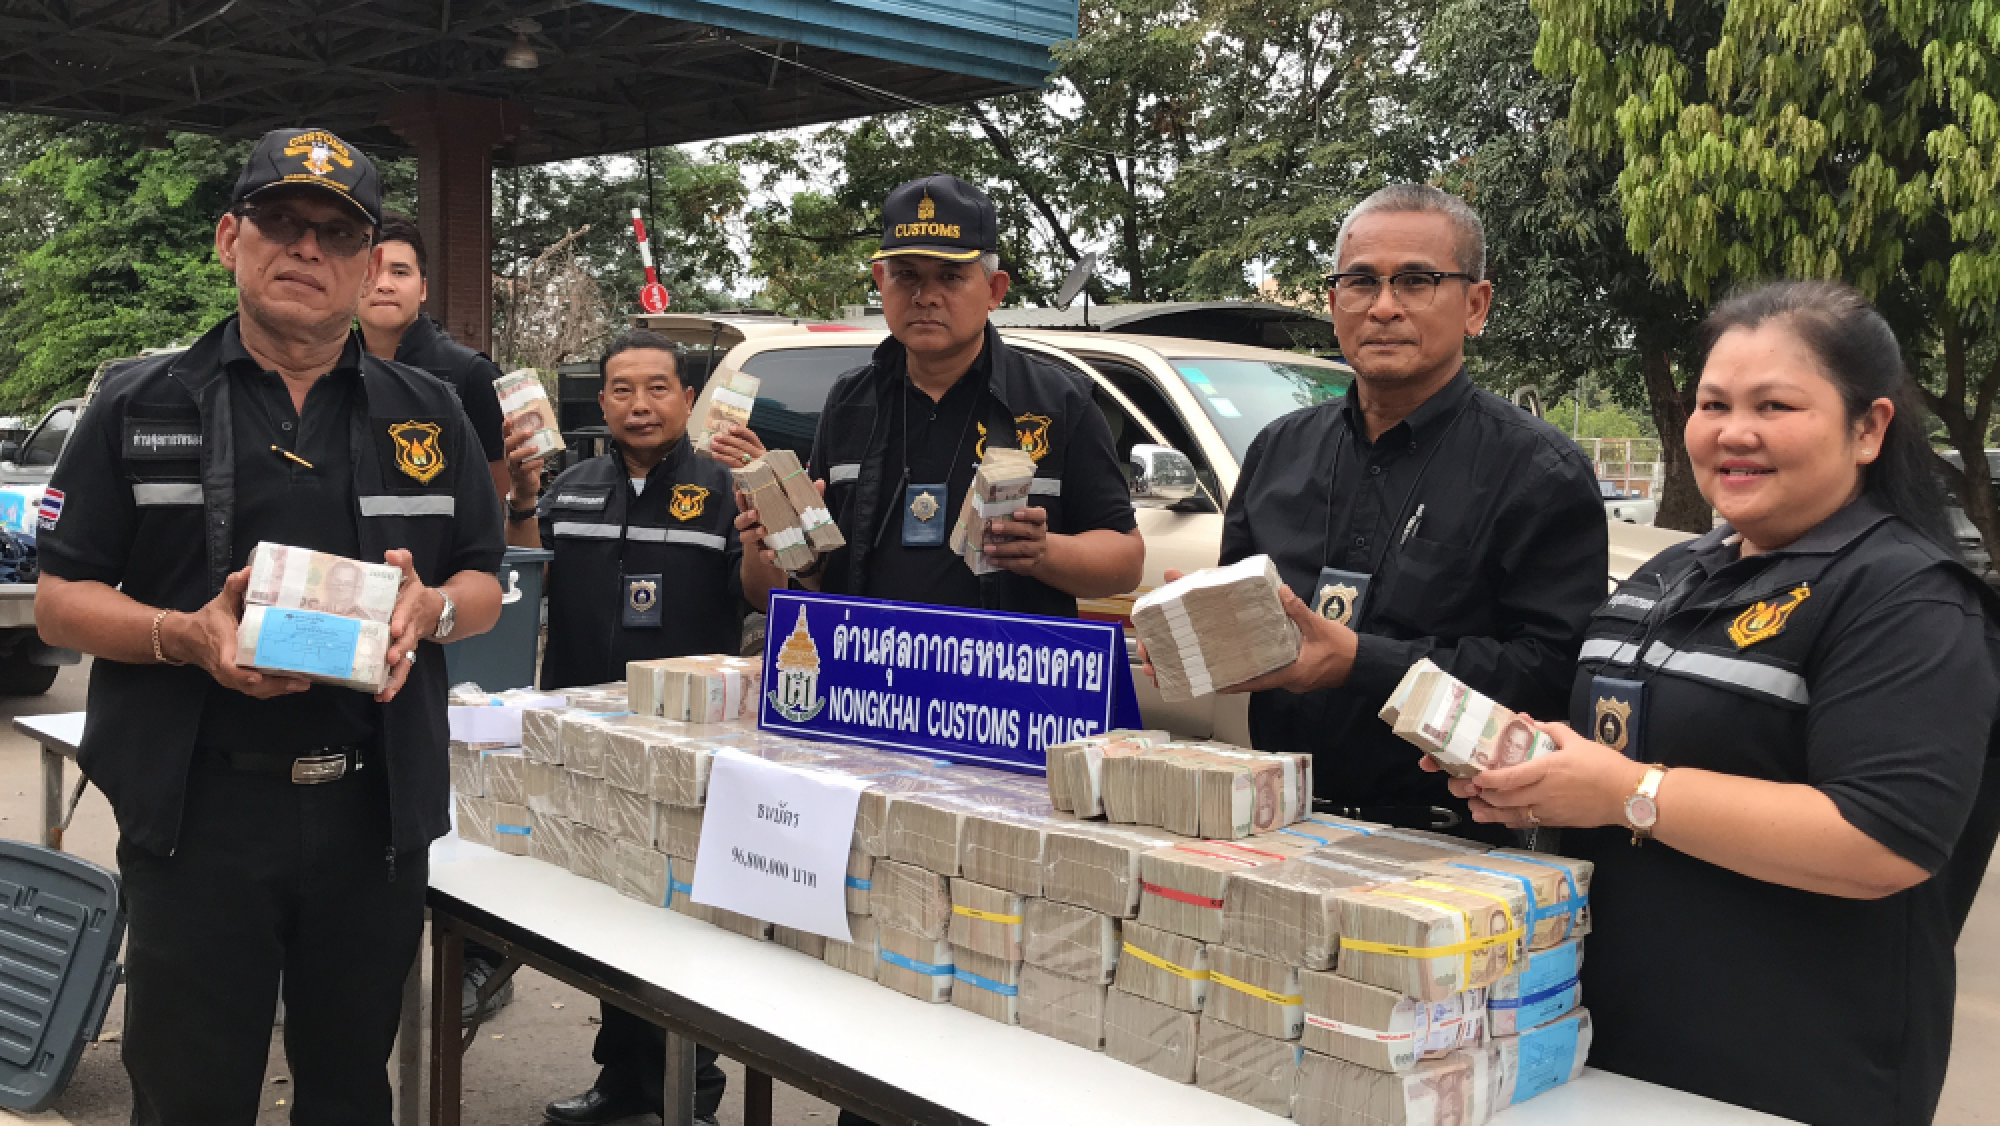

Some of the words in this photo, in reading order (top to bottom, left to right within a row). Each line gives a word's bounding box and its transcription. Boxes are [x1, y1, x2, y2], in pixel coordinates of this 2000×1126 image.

[894, 222, 961, 238] CUSTOMS
[832, 608, 1104, 692] ด่านศุลกากรหนองคาย
[829, 685, 921, 733] NONGKHAI
[926, 697, 1021, 749] CUSTOMS
[731, 845, 789, 880] 96,800,000
